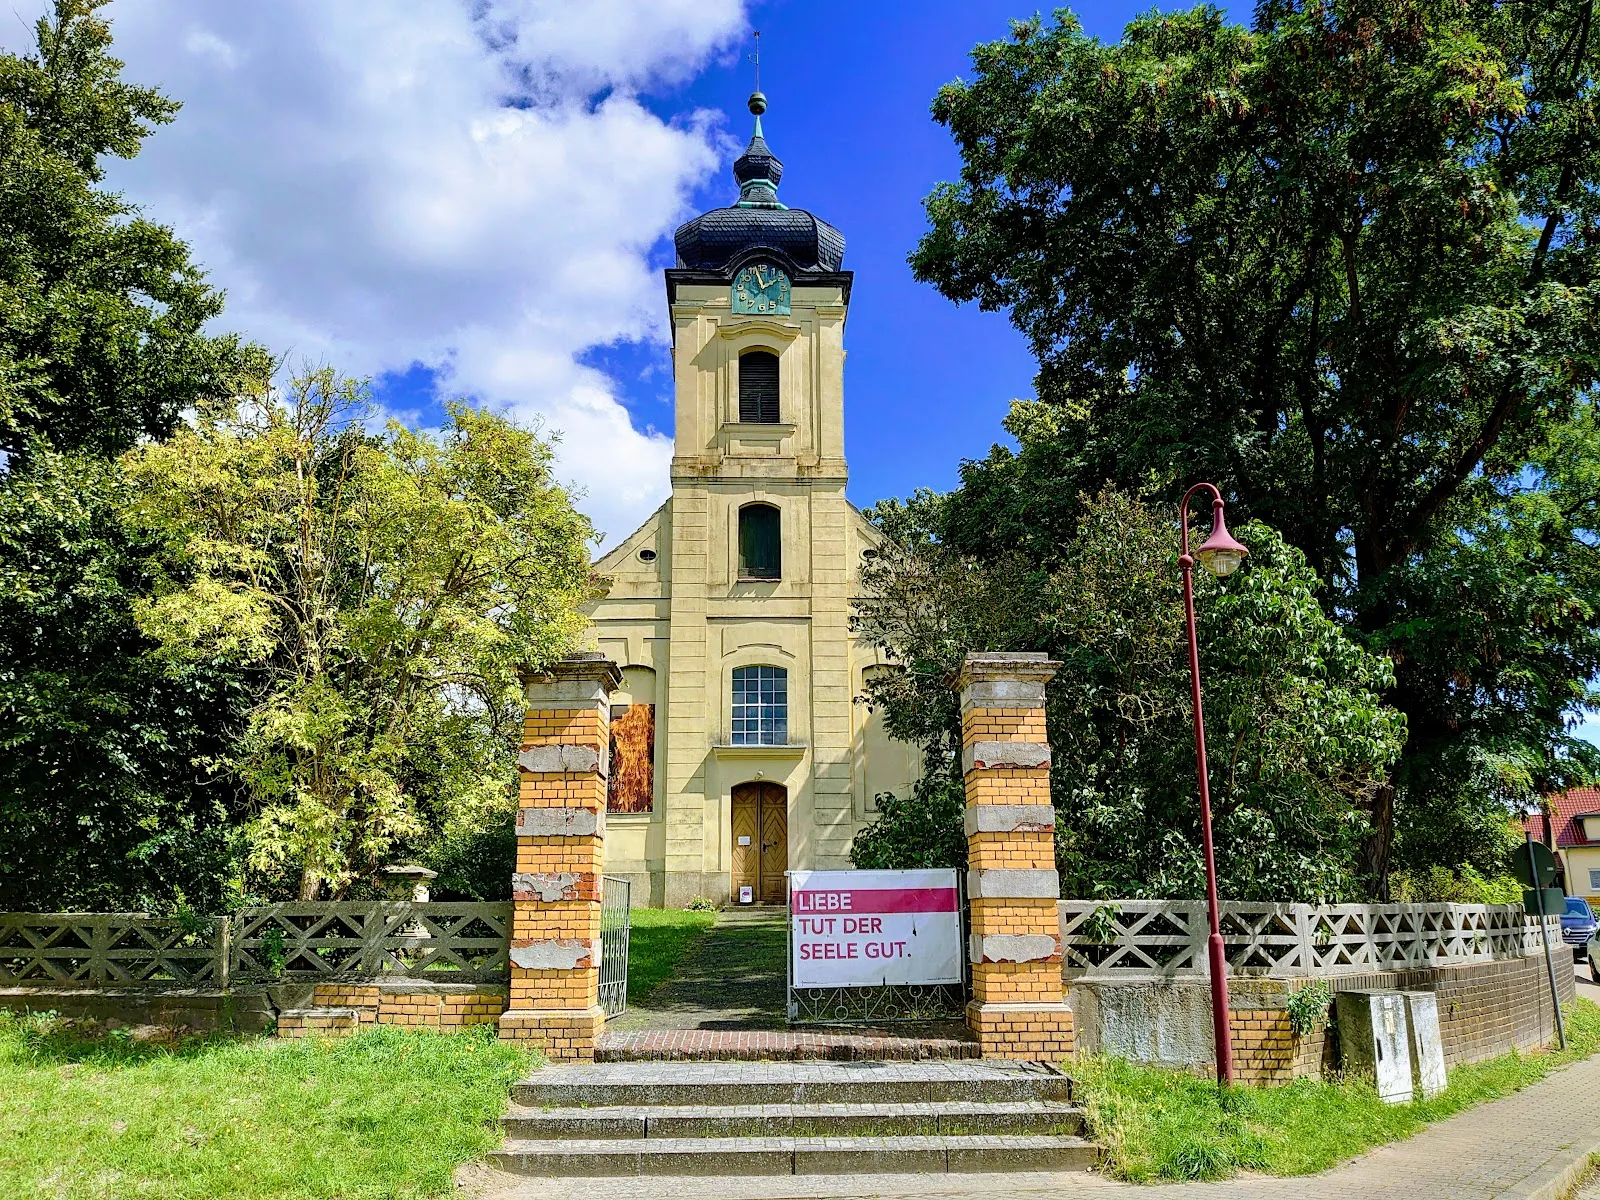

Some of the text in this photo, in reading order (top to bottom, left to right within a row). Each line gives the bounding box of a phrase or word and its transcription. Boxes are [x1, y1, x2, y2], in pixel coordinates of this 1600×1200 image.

[748, 267, 756, 275] 11
[758, 264, 768, 272] 12
[741, 274, 751, 282] 10
[737, 283, 744, 291] 9
[799, 892, 852, 910] LIEBE
[799, 917, 883, 934] TUT DER
[800, 941, 912, 960] SEELE GUT.
